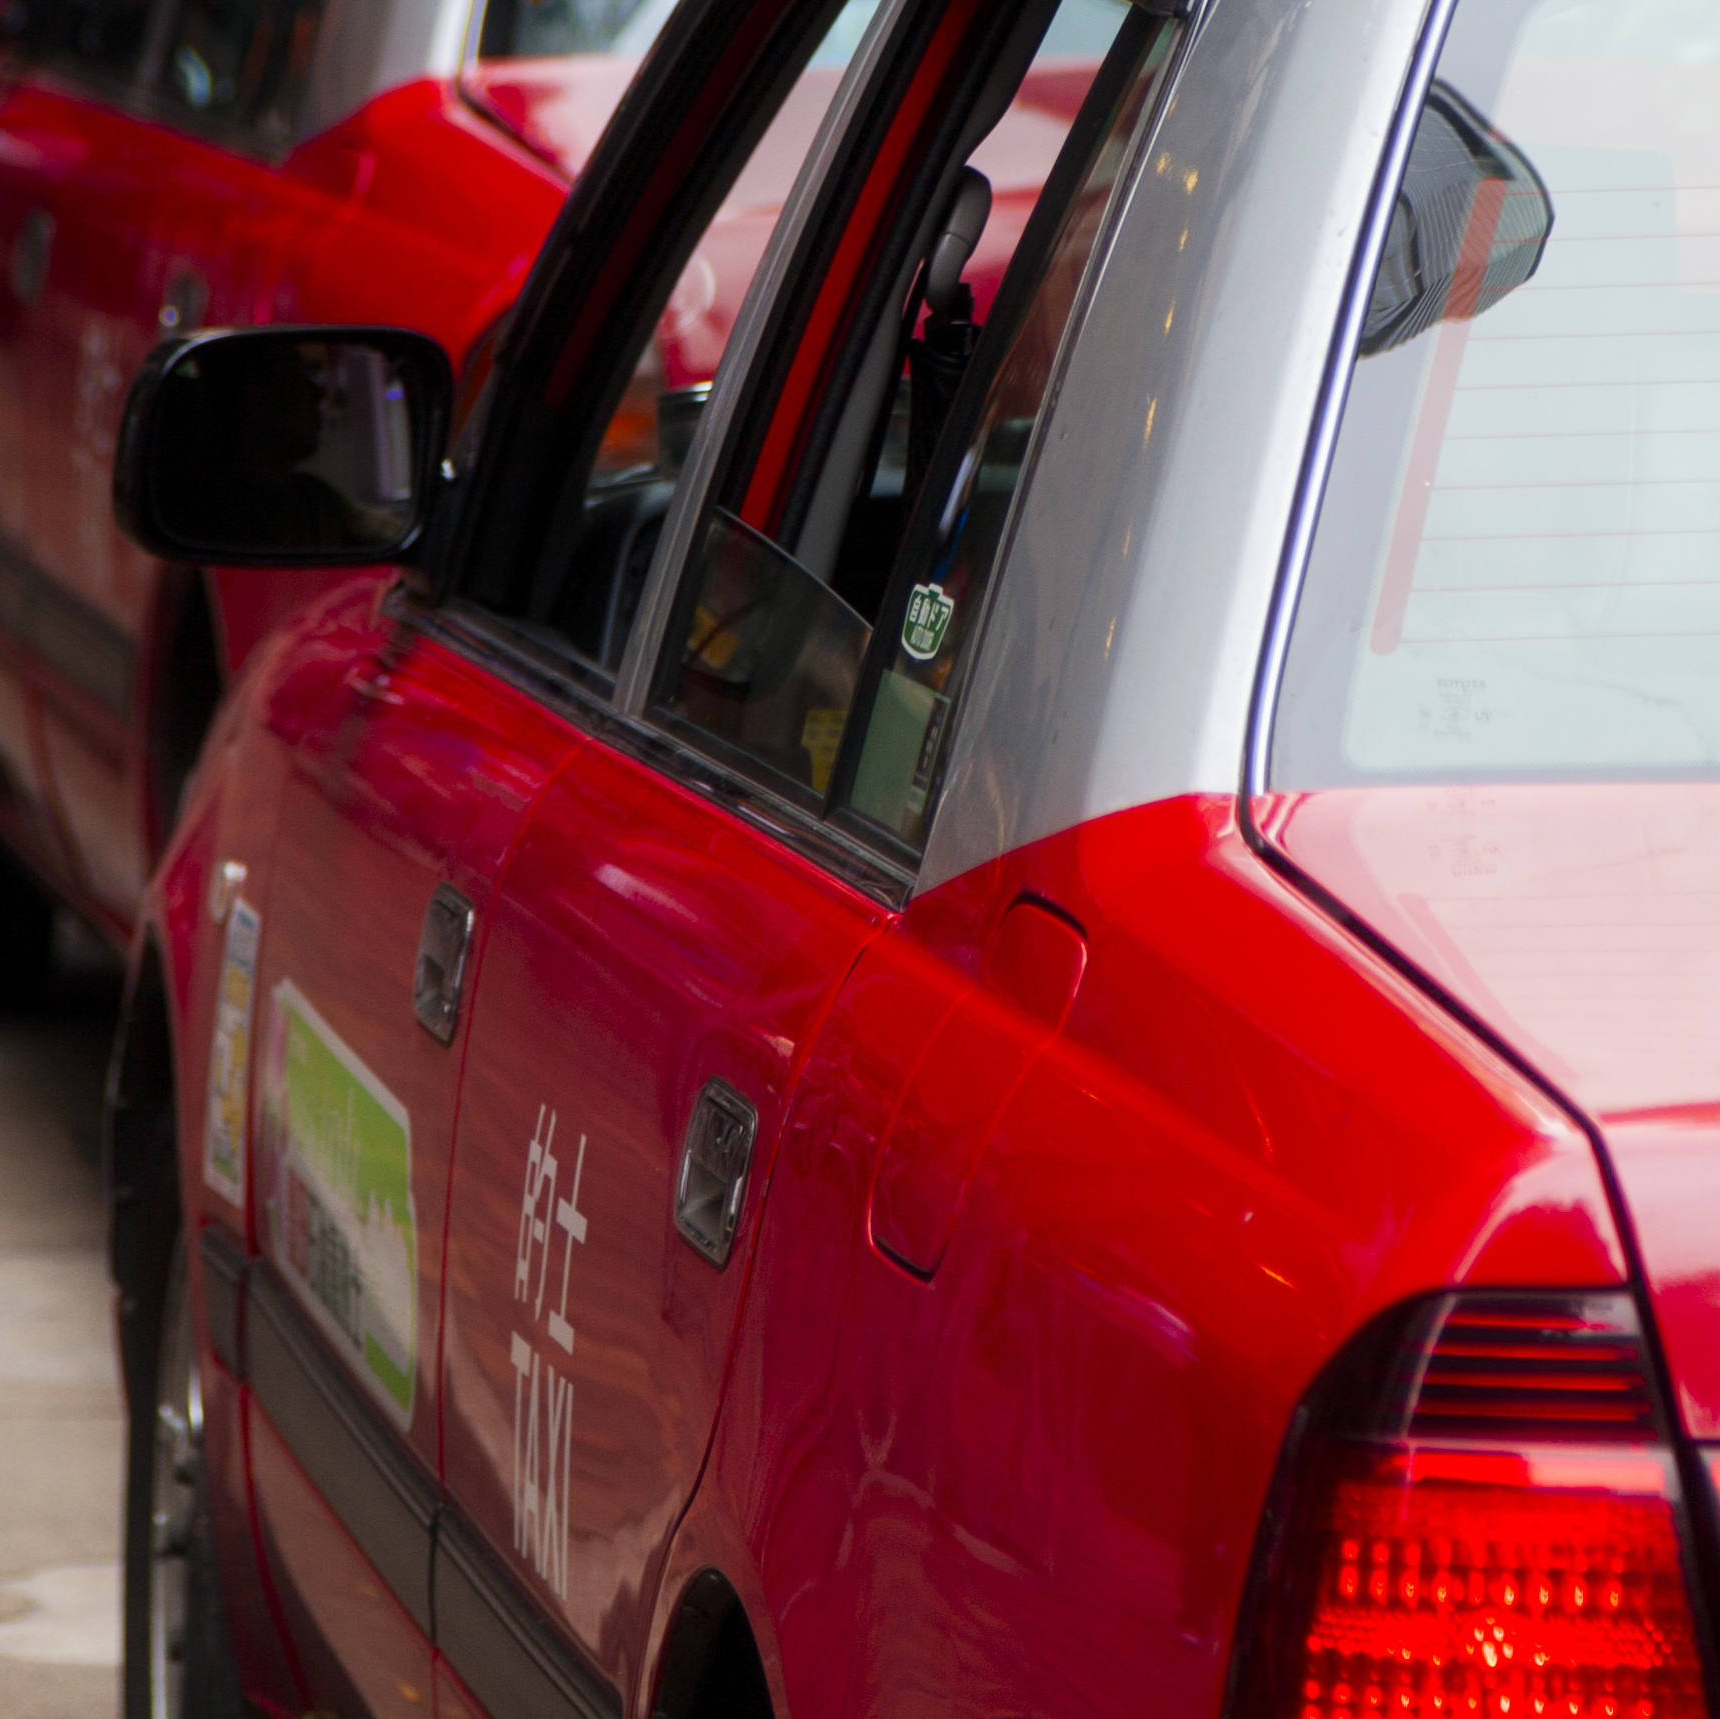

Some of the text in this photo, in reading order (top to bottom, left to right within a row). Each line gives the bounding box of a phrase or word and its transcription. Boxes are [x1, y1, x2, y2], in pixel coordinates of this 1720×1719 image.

[1436, 677, 1487, 690] TOYOTA
[514, 1103, 588, 1358] 的士
[510, 1330, 574, 1602] TAXI
